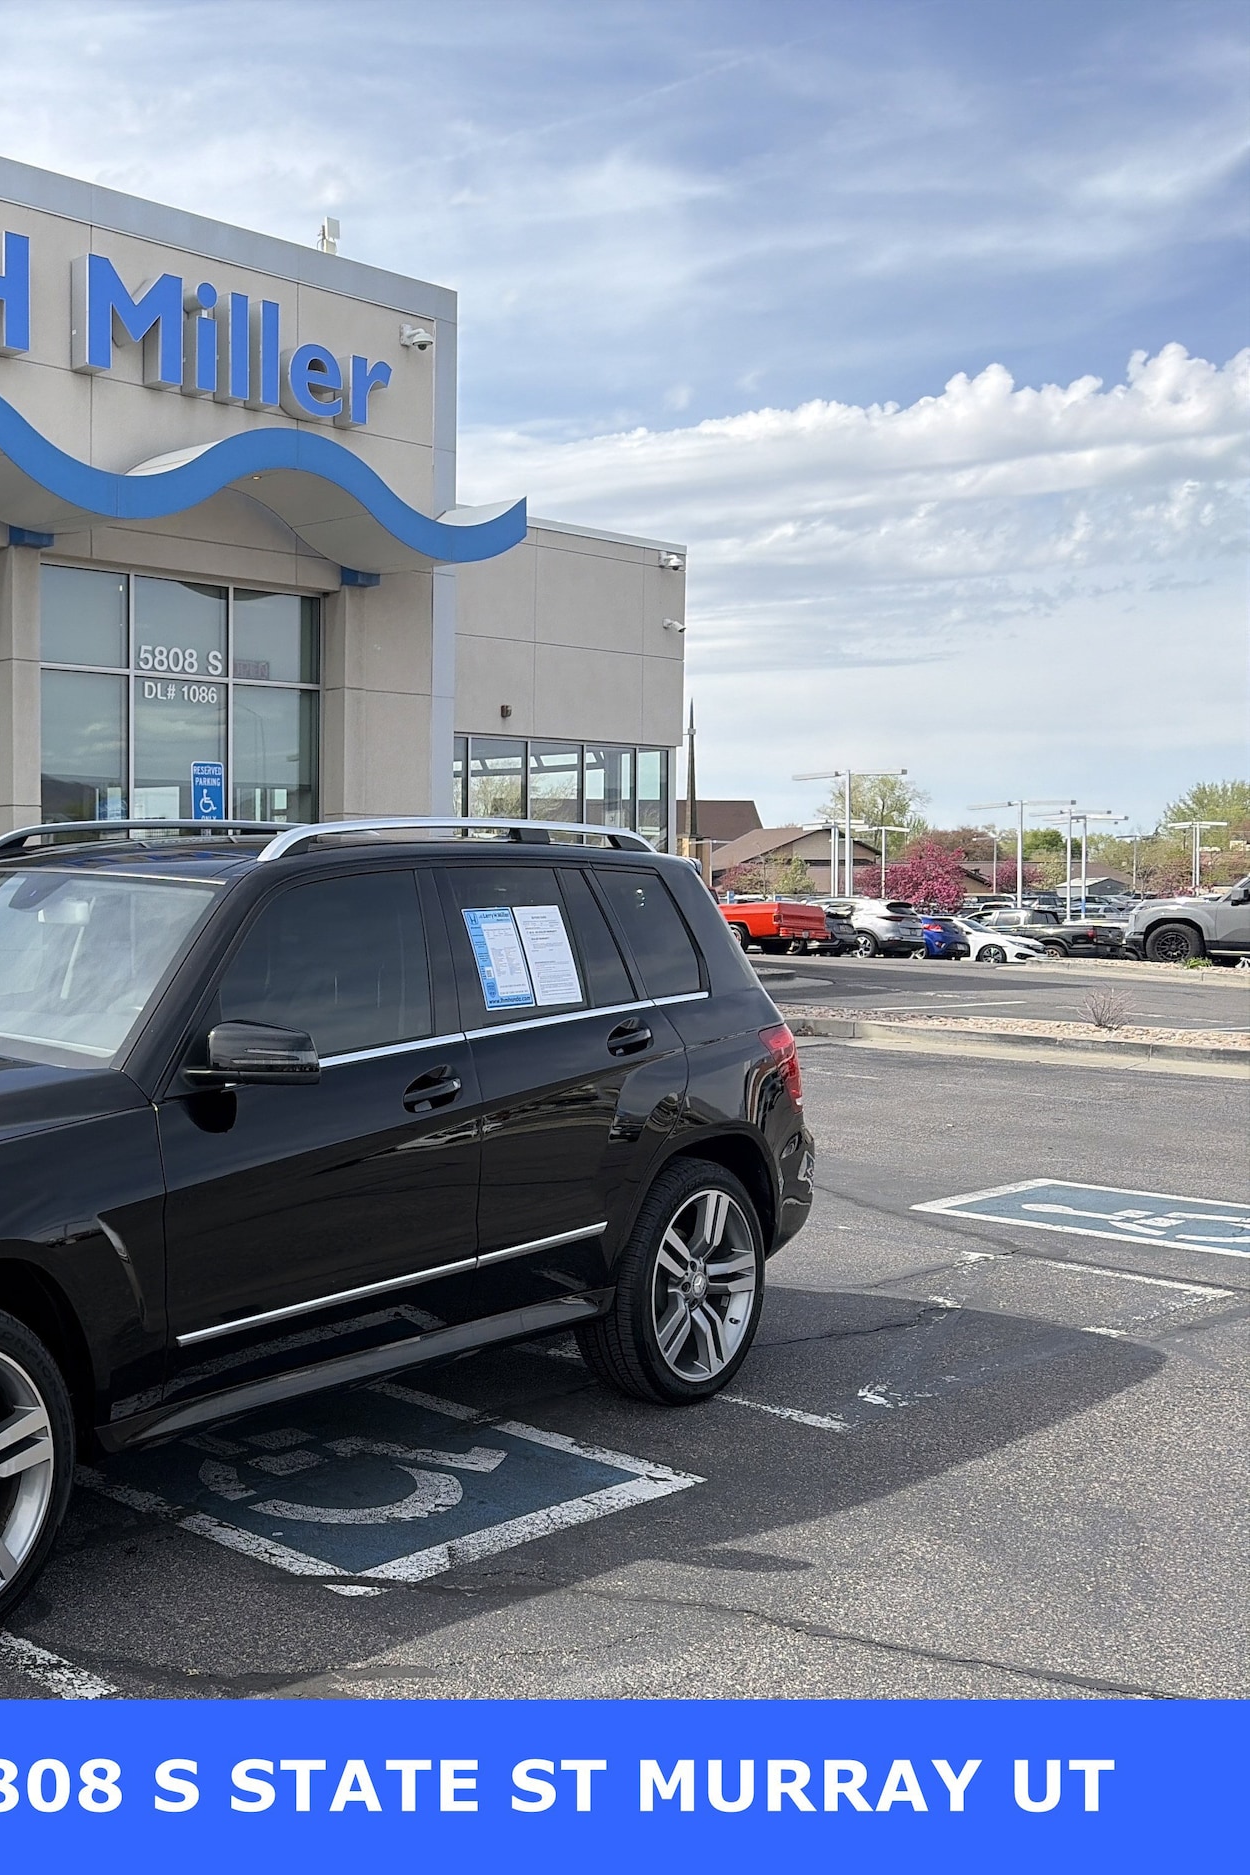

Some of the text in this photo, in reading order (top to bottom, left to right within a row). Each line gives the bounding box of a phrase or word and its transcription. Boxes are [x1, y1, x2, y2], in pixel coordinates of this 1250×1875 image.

[73, 253, 393, 428] Miller
[139, 644, 223, 676] 5808 S
[143, 681, 217, 703] DL# 1086
[193, 765, 222, 776] RESERVED
[195, 777, 221, 787] PARKING
